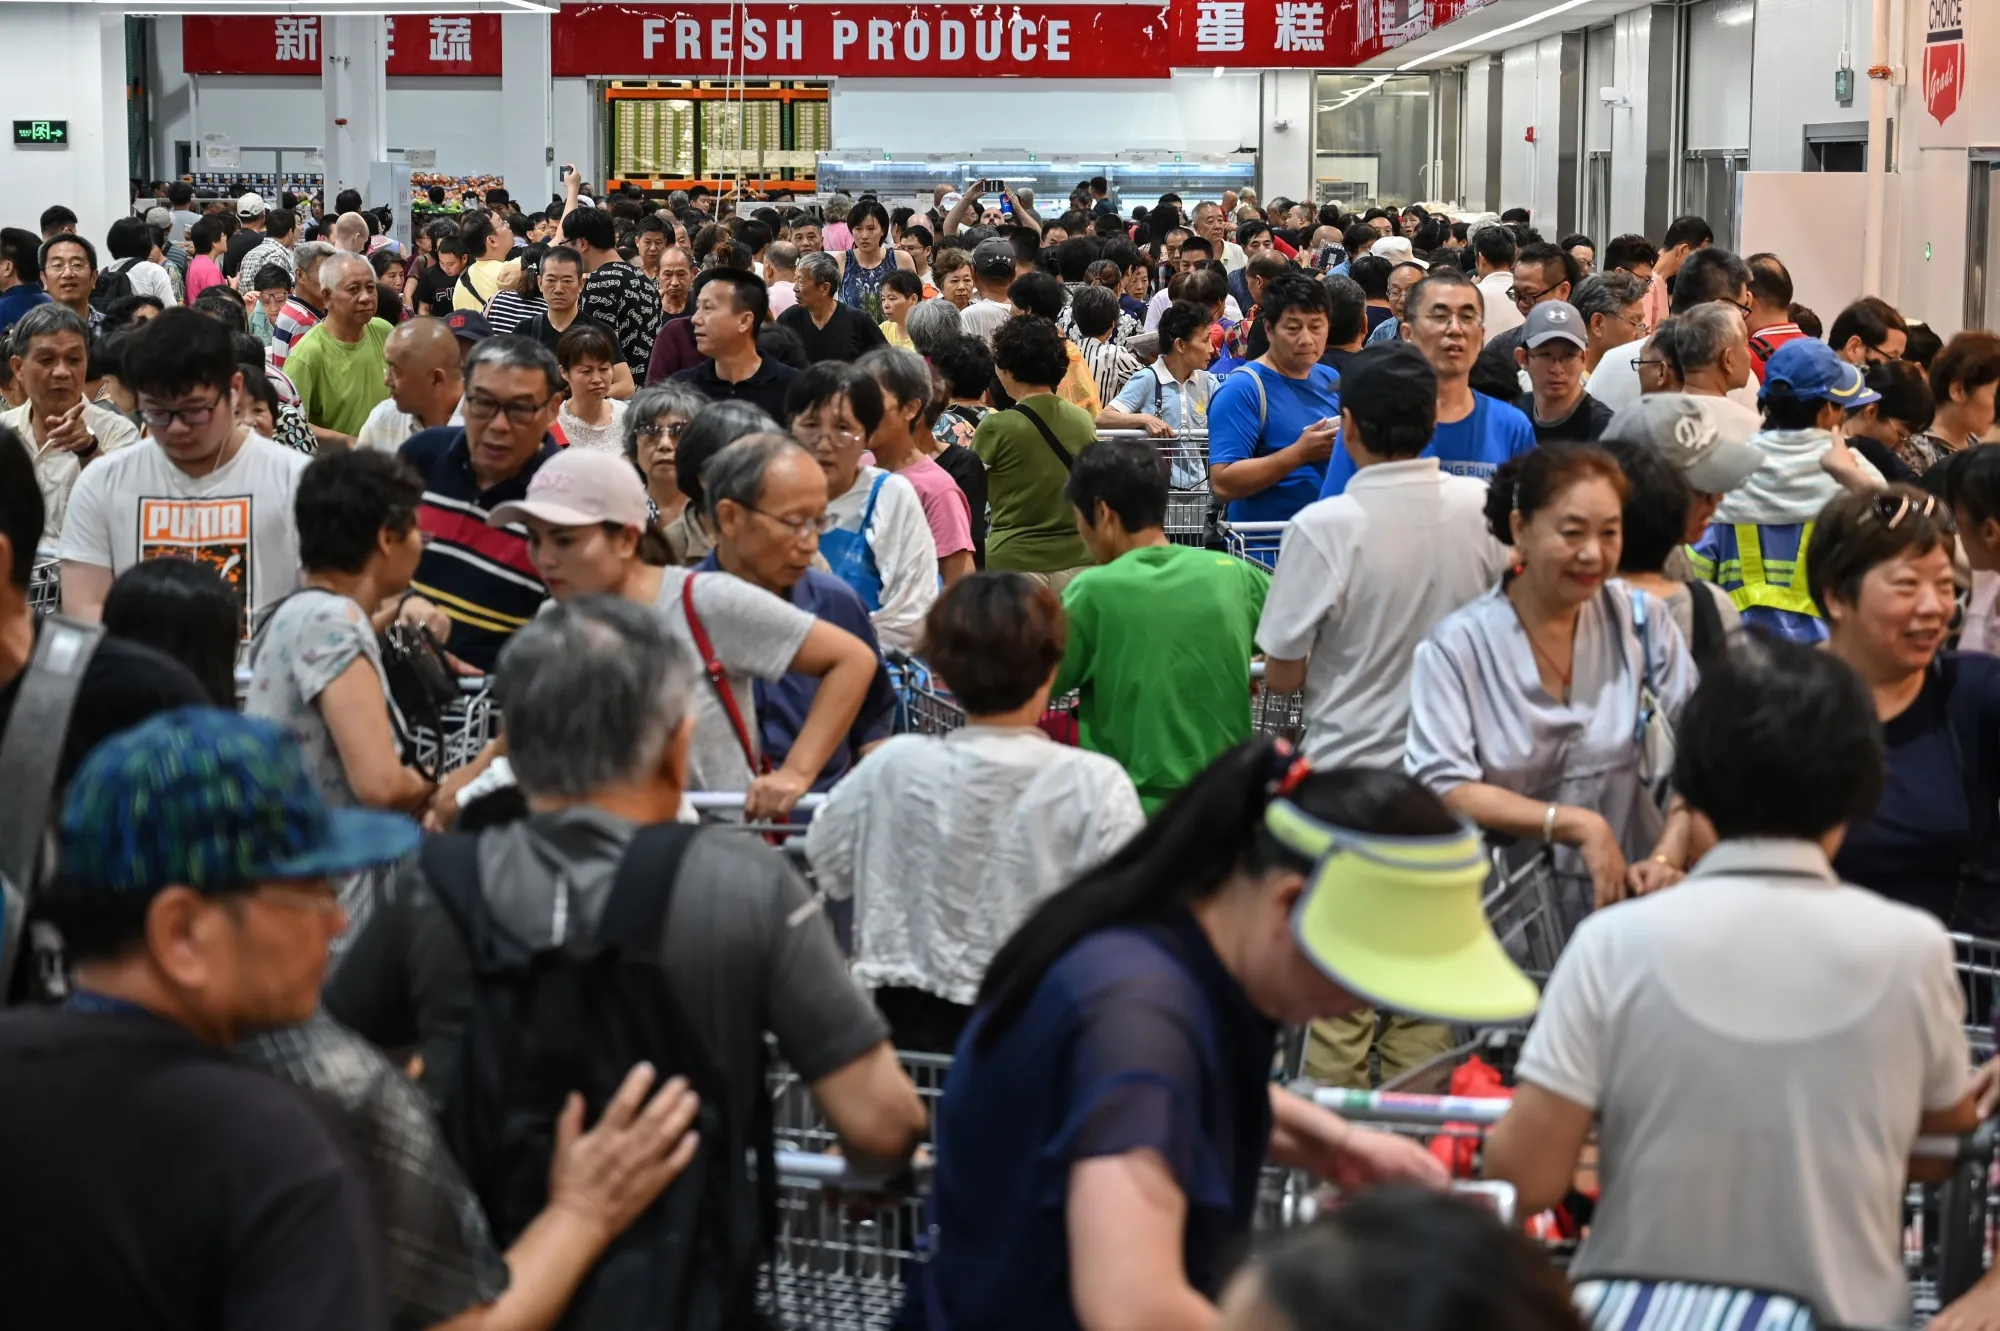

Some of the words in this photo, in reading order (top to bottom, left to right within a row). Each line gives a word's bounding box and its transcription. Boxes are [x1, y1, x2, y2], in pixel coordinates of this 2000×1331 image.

[1929, 0, 1962, 30] CHOICE
[642, 19, 802, 60] FRESH
[833, 19, 1070, 61] PRODUCE
[1930, 58, 1954, 111] Grade
[149, 505, 242, 538] PUMA
